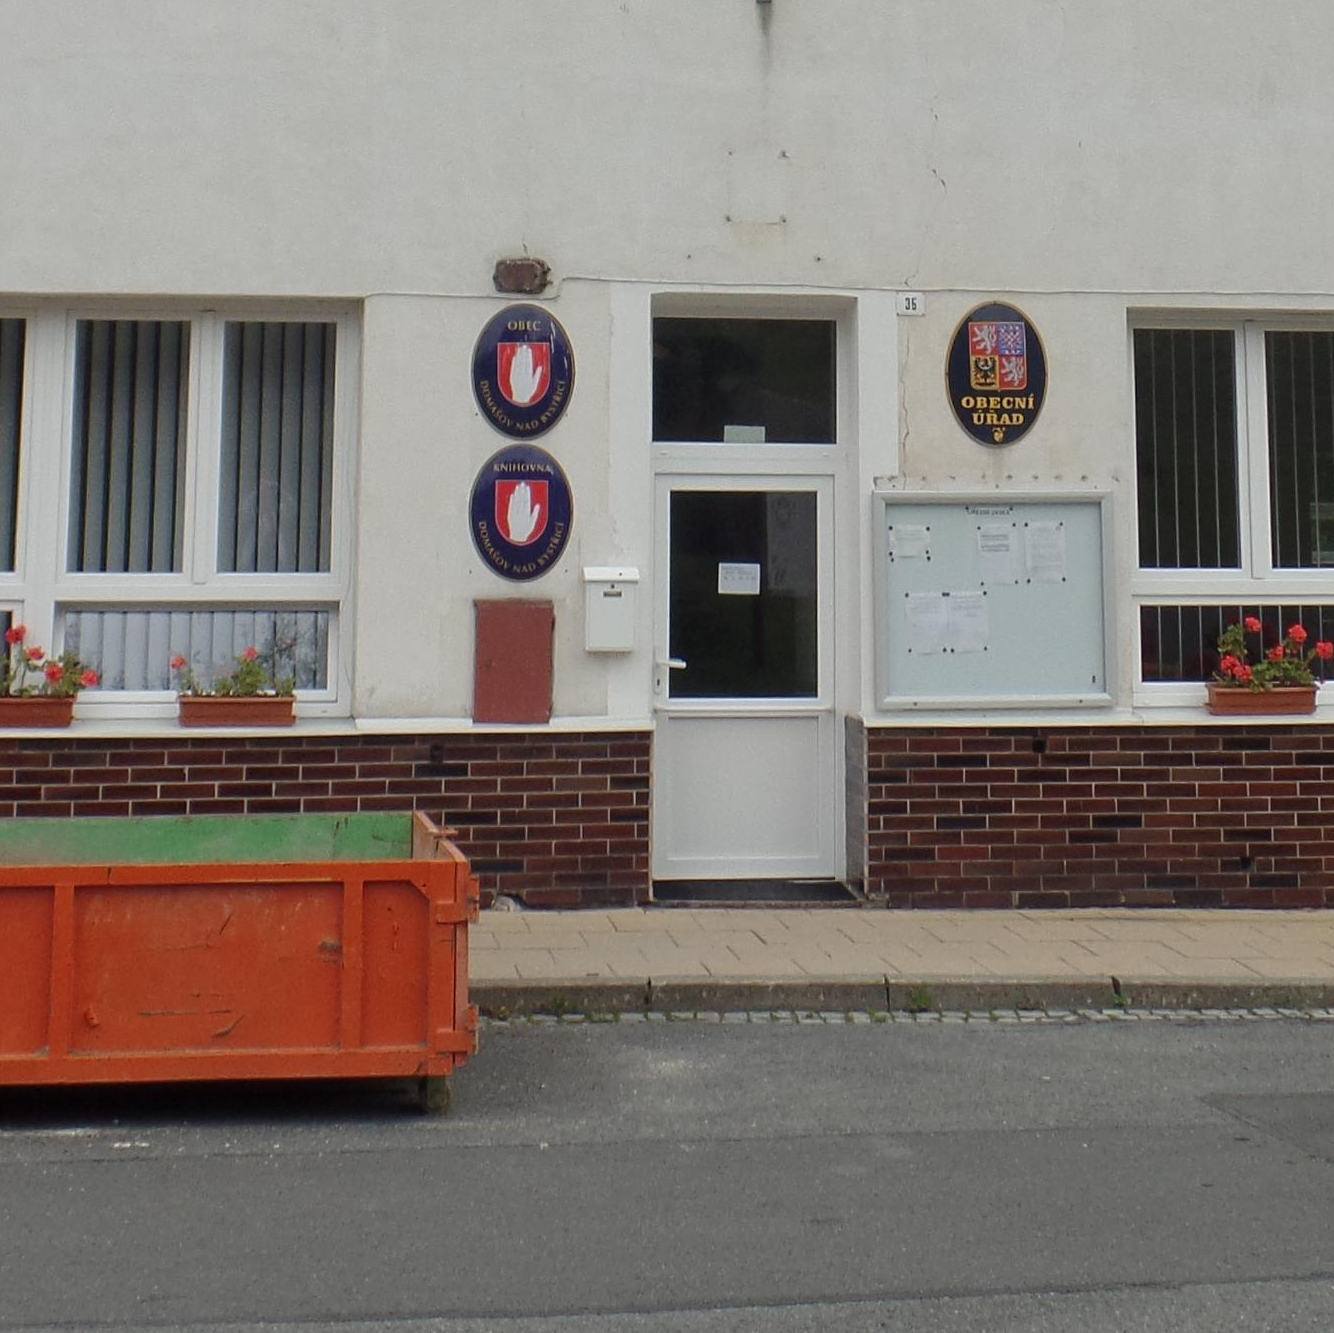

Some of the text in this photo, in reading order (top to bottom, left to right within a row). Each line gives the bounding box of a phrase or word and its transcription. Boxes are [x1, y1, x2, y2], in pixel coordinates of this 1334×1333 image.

[507, 320, 541, 331] OBEC
[961, 393, 1035, 409] OBECNÍ
[972, 409, 1024, 425] ÚŘAD
[515, 419, 539, 431] NAD
[493, 462, 554, 475] KNIHOVNA
[513, 562, 537, 573] NAD
